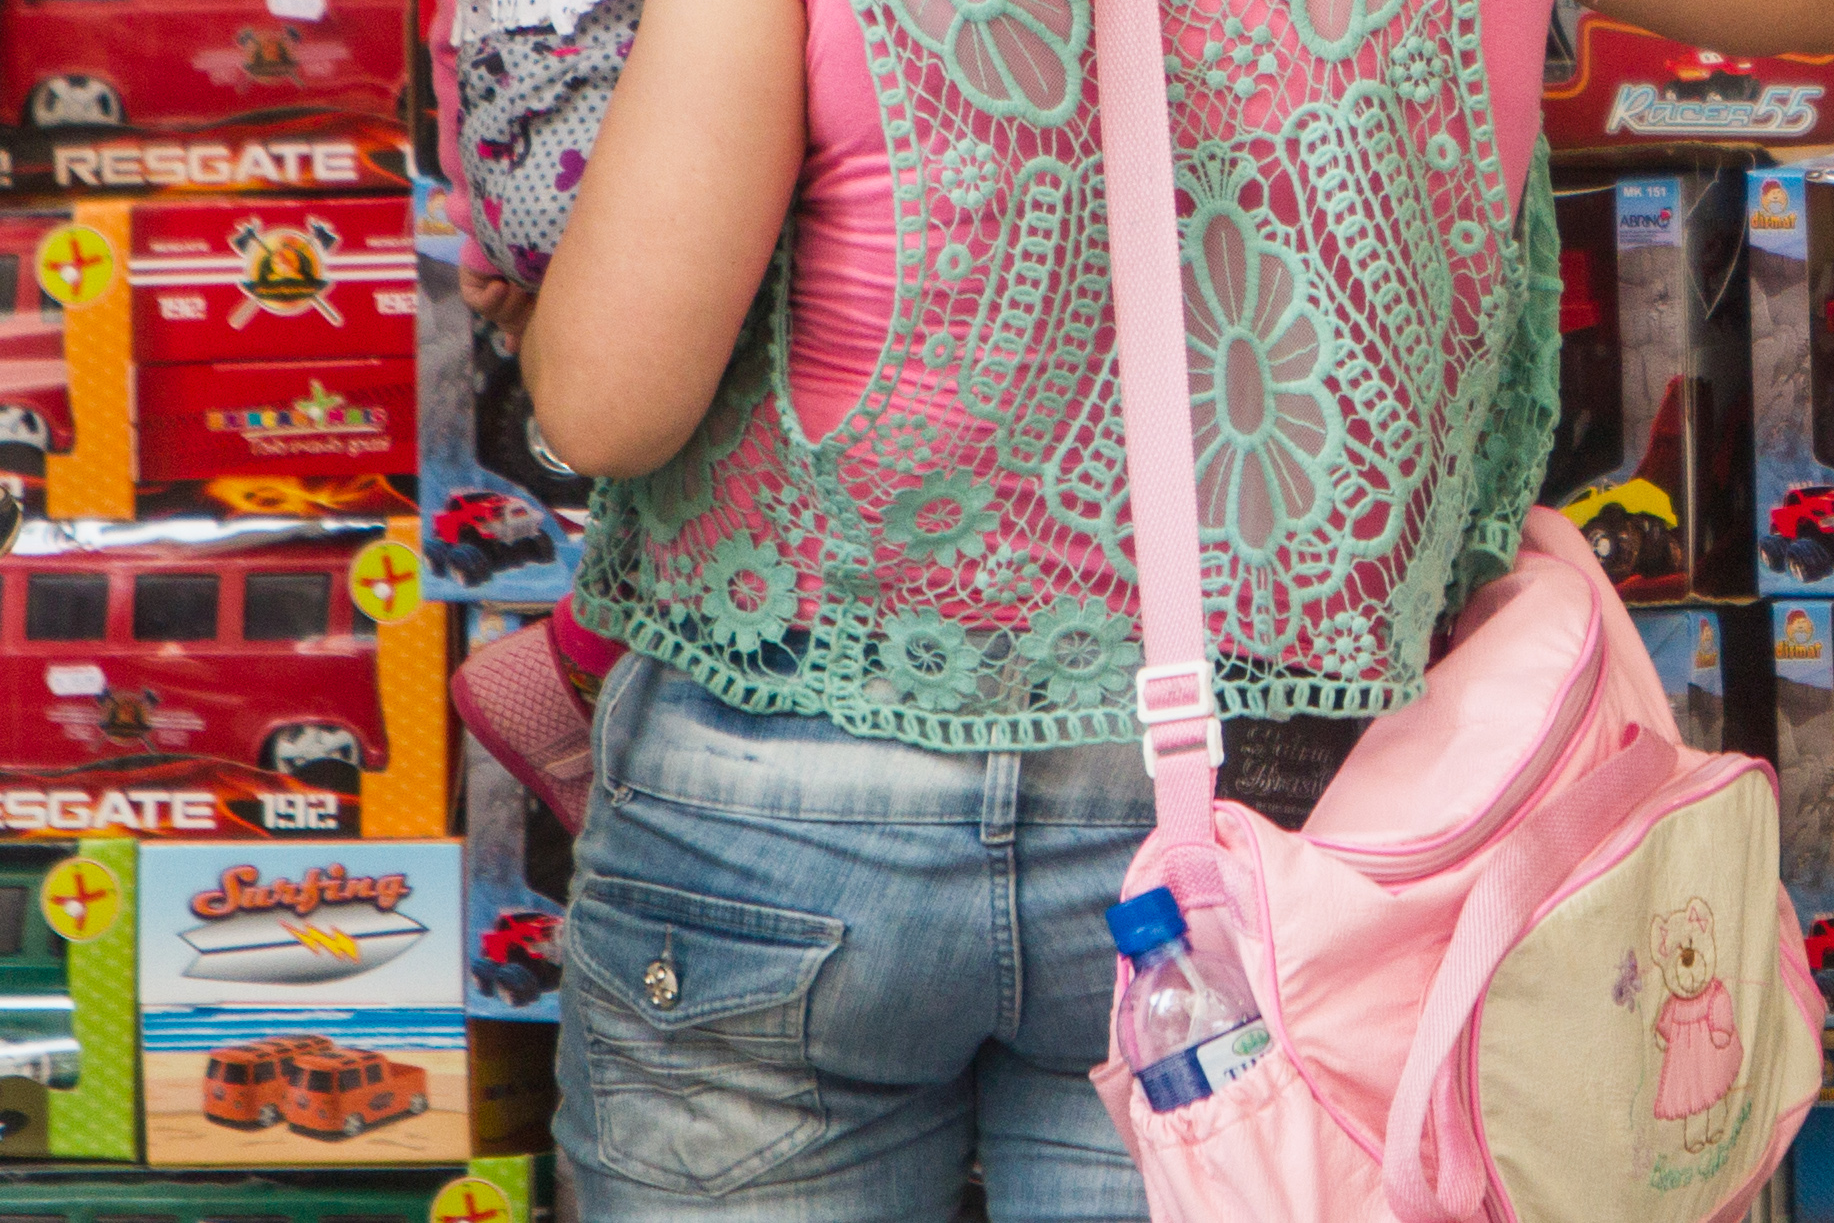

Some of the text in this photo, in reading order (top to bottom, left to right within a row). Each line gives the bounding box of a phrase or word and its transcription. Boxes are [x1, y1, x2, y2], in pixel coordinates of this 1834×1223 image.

[53, 142, 360, 189] RESGATE
[1647, 185, 1668, 198] 151
[0, 789, 339, 830] SGATE 192
[189, 862, 413, 921] Surfing
